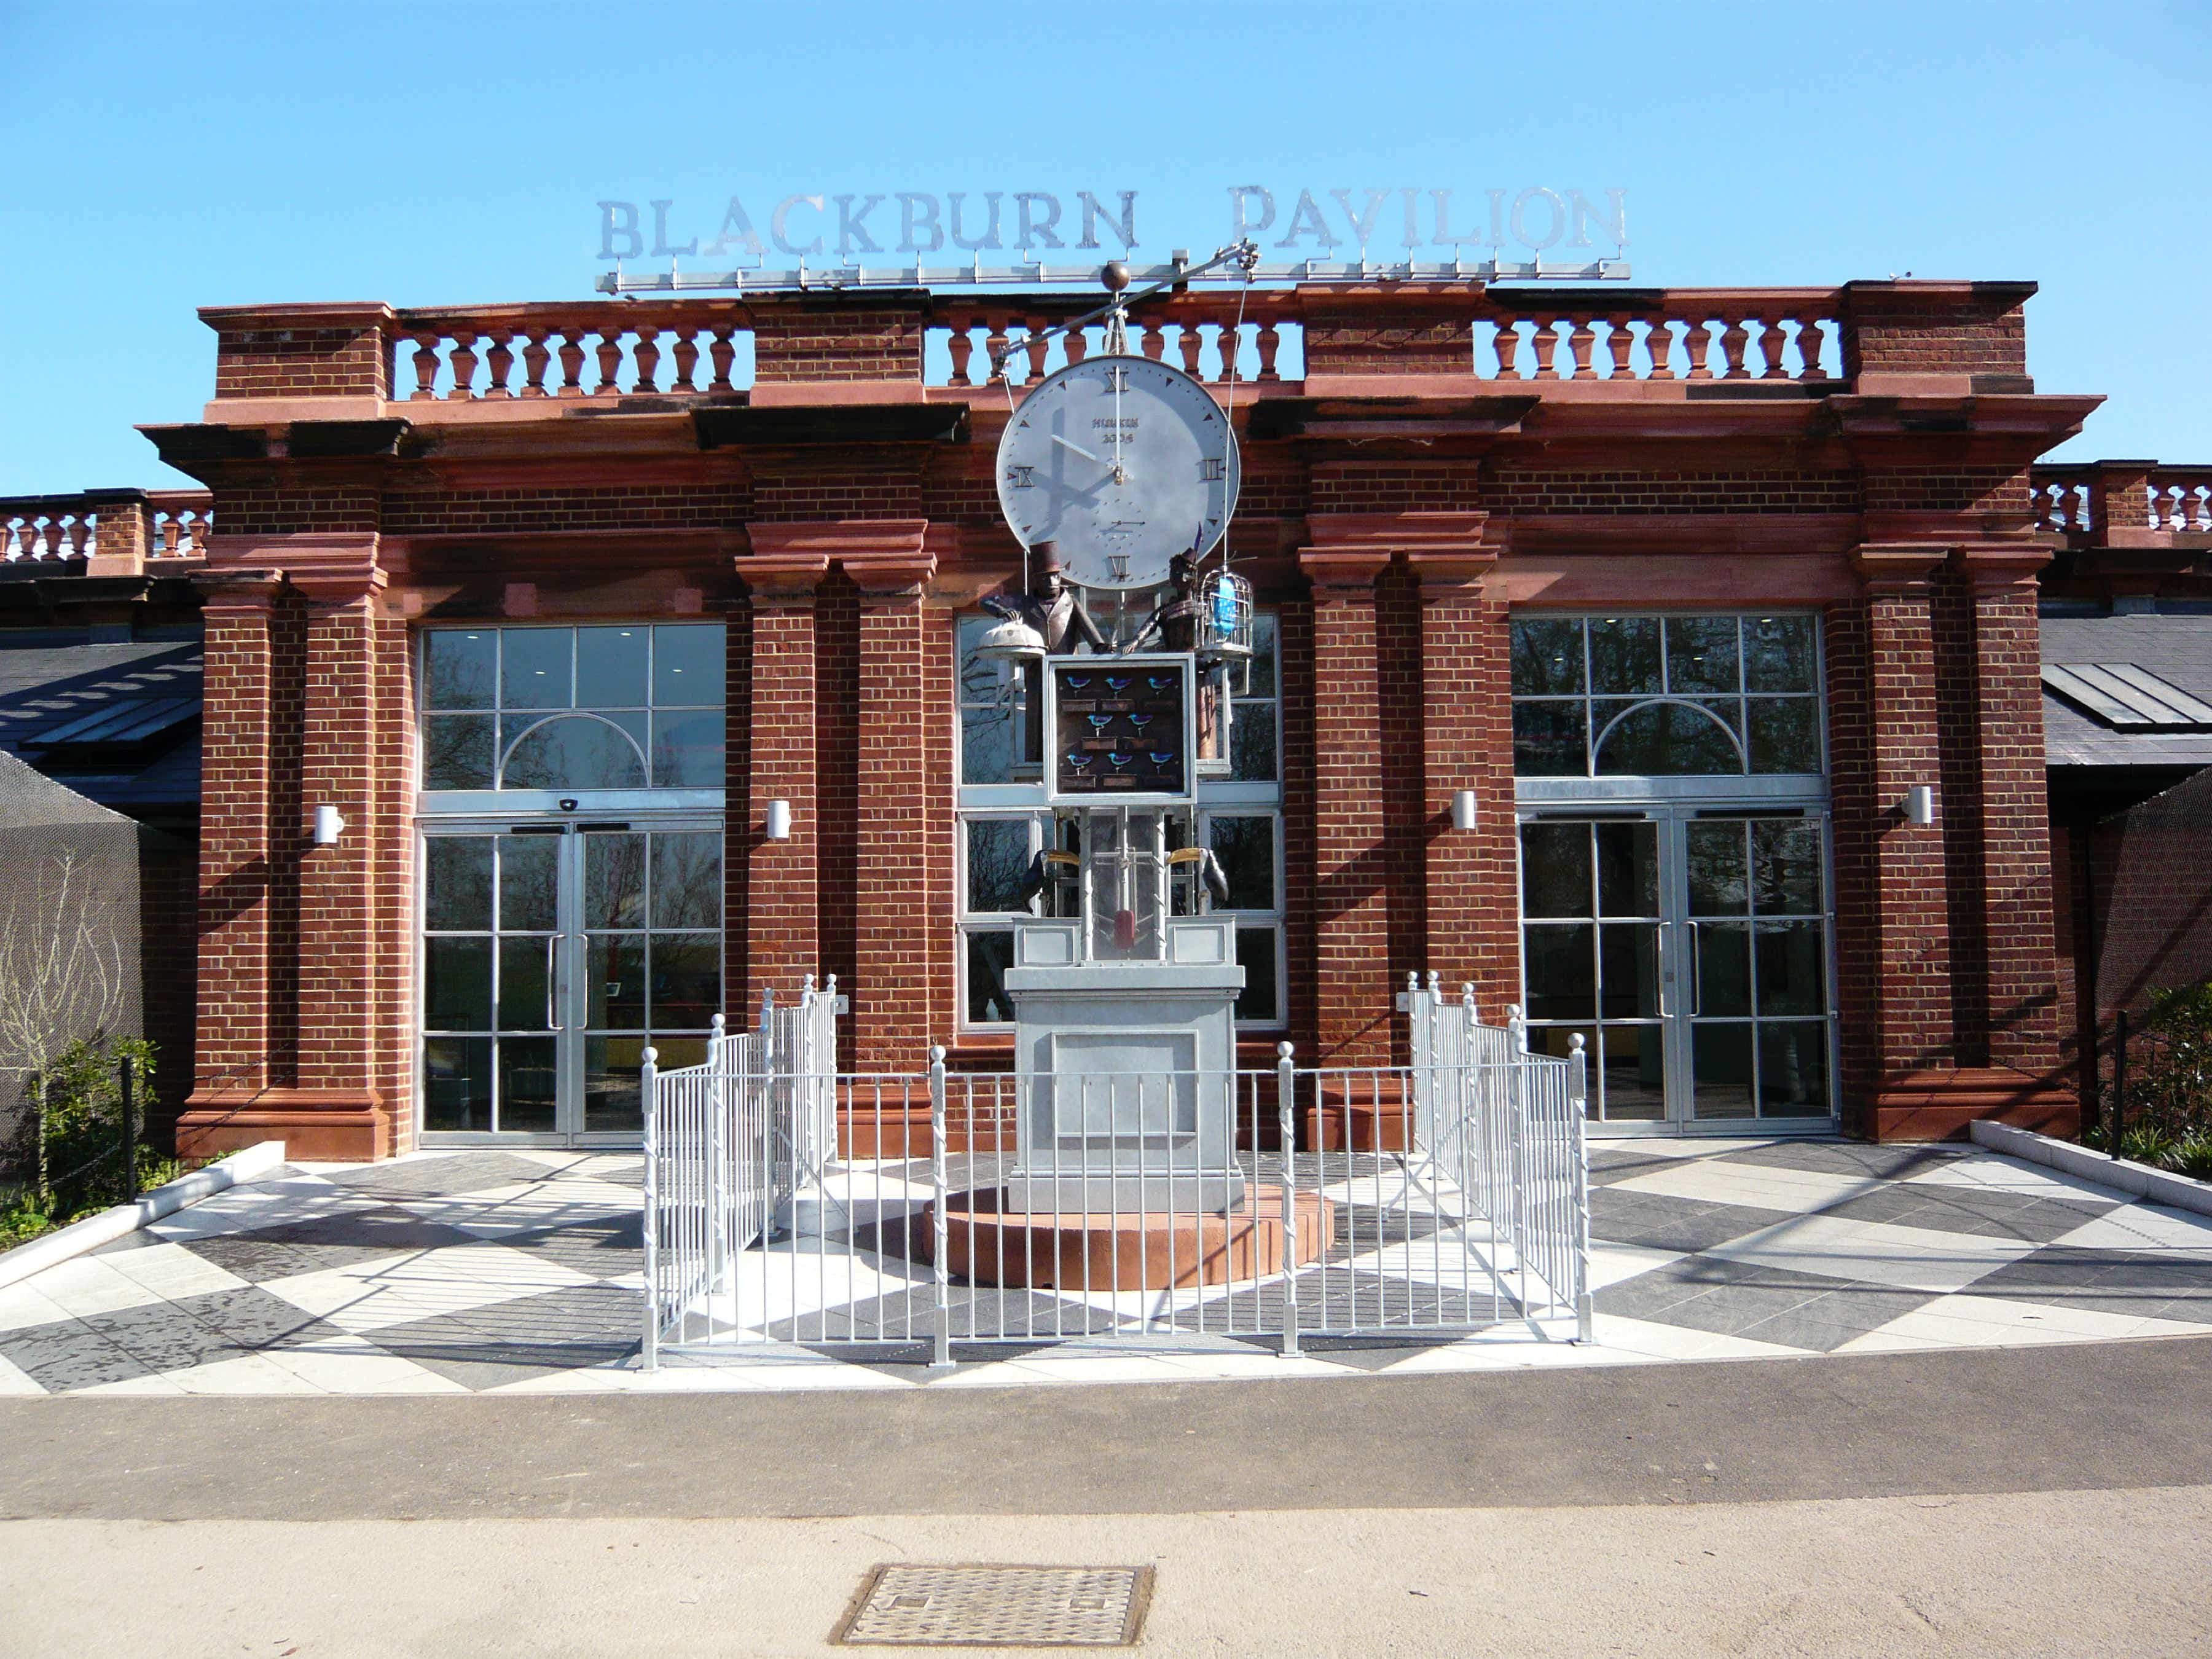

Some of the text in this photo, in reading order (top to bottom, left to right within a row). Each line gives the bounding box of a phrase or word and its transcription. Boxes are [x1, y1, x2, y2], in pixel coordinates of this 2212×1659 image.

[596, 185, 1628, 259] BLACKBURN PAVILION
[1014, 466, 1035, 487] IX
[1202, 458, 1222, 480] III
